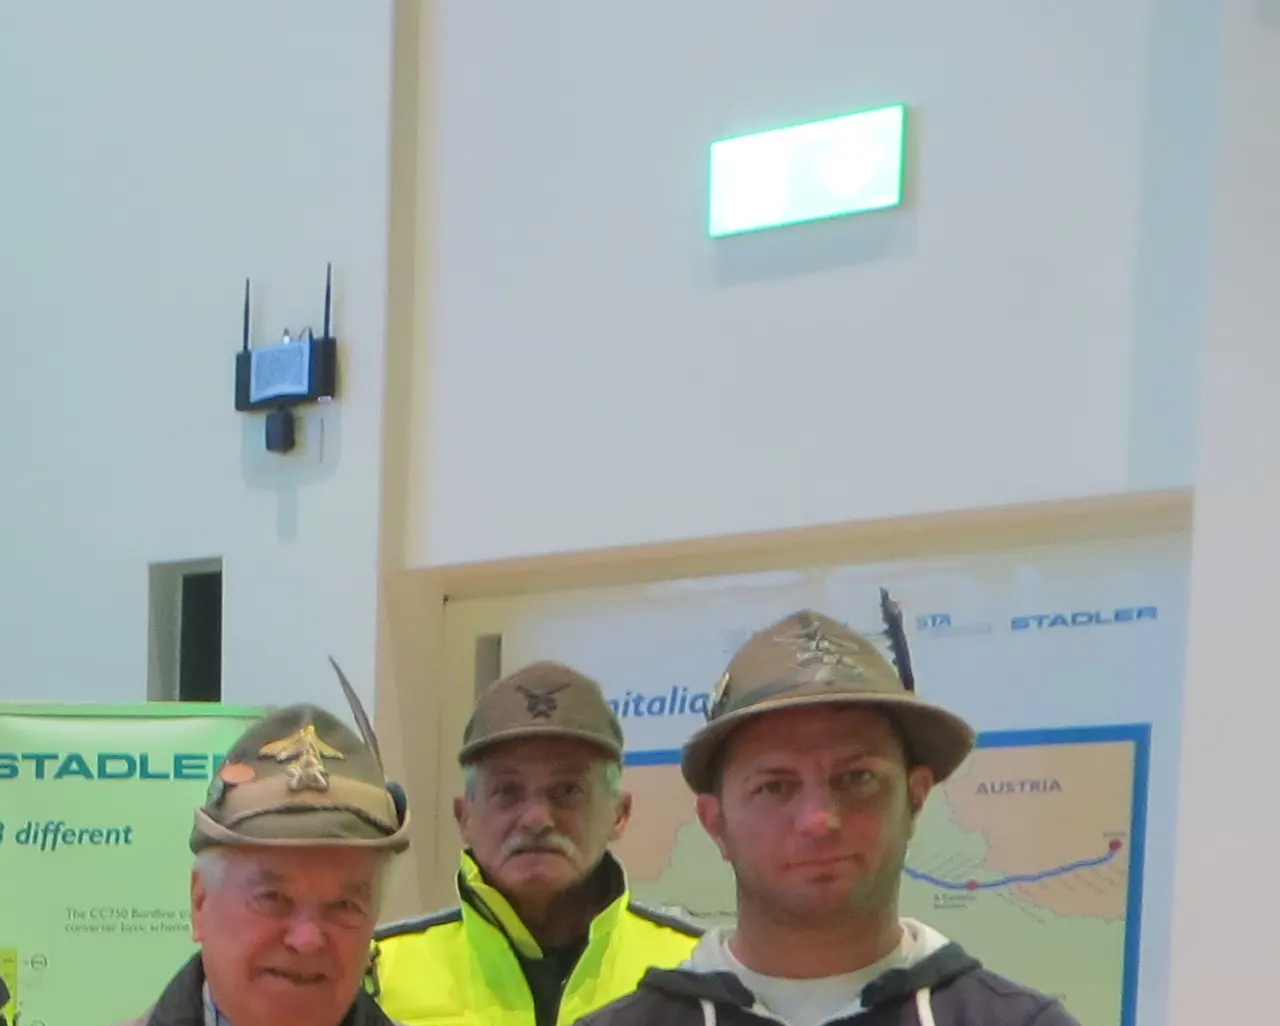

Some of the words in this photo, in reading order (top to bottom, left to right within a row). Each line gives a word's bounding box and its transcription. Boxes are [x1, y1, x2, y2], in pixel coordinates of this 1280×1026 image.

[1010, 606, 1158, 631] STADLER
[975, 779, 1062, 796] AUSTRIA
[15, 819, 134, 852] different
